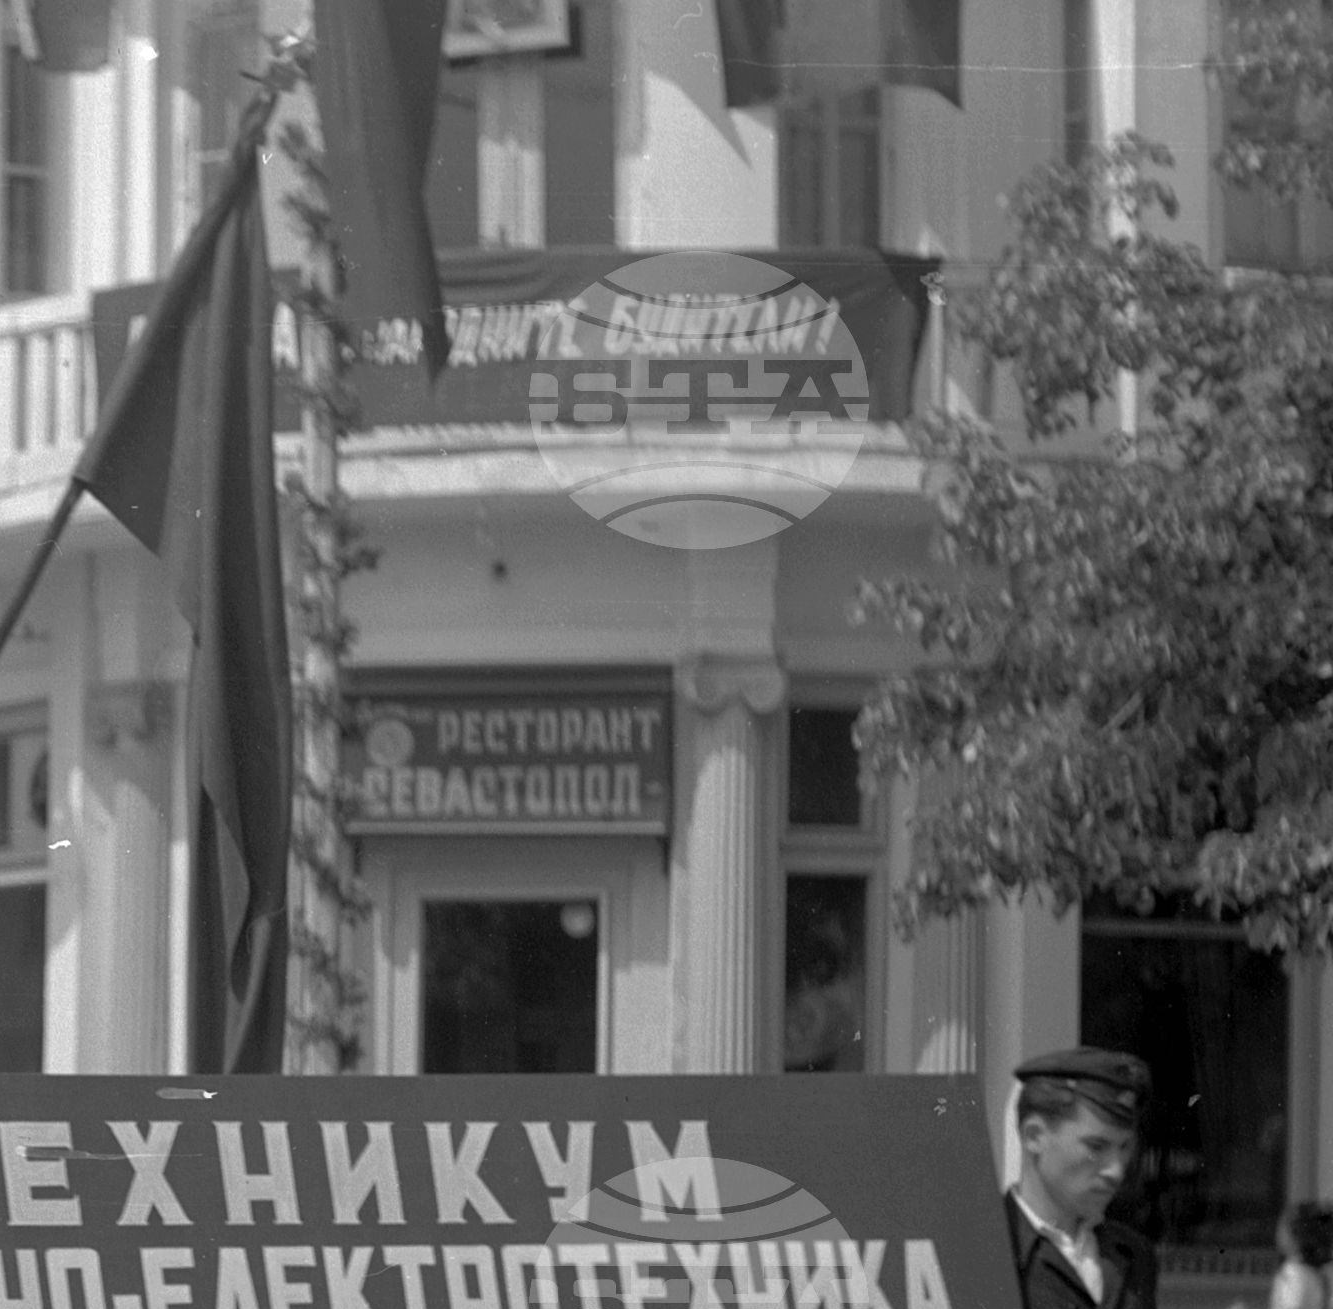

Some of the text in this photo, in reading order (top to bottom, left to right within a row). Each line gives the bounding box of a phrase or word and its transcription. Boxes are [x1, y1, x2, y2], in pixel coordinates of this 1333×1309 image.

[341, 302, 589, 367] АРДНИТЕ
[436, 707, 662, 753] РЕСТОРАНТ
[362, 763, 642, 817] СЕВАСТОПОЛ
